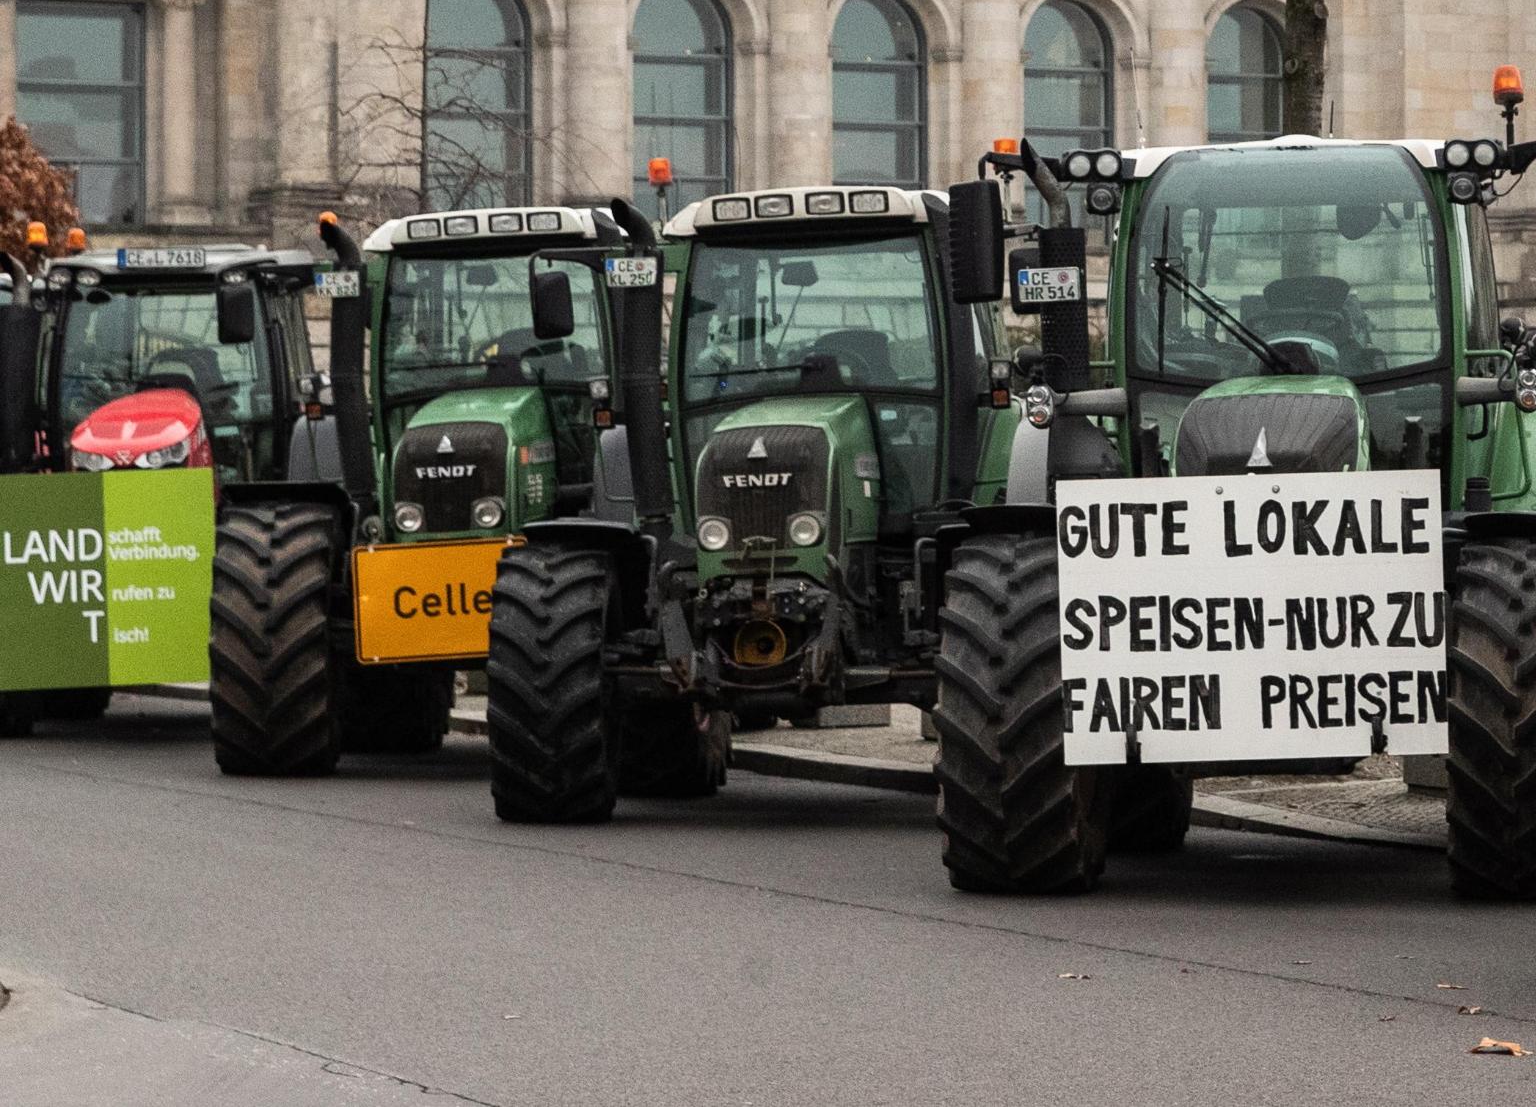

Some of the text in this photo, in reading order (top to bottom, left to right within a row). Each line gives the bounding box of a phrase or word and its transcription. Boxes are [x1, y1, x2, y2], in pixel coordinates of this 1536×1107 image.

[618, 260, 633, 272] CE
[1031, 272, 1051, 285] CE
[1025, 285, 1075, 300] HR 514
[415, 465, 477, 479] FENDT
[722, 473, 792, 488] FENDT
[109, 526, 161, 544] schafft
[1059, 497, 1430, 558] GUTE LOKALE
[3, 528, 103, 564] LAND
[27, 569, 105, 604] WIR
[112, 585, 175, 601] rufen zu
[394, 583, 492, 619] Celle
[82, 610, 105, 643] T
[1063, 670, 1448, 733] FAIREN PREISEN
